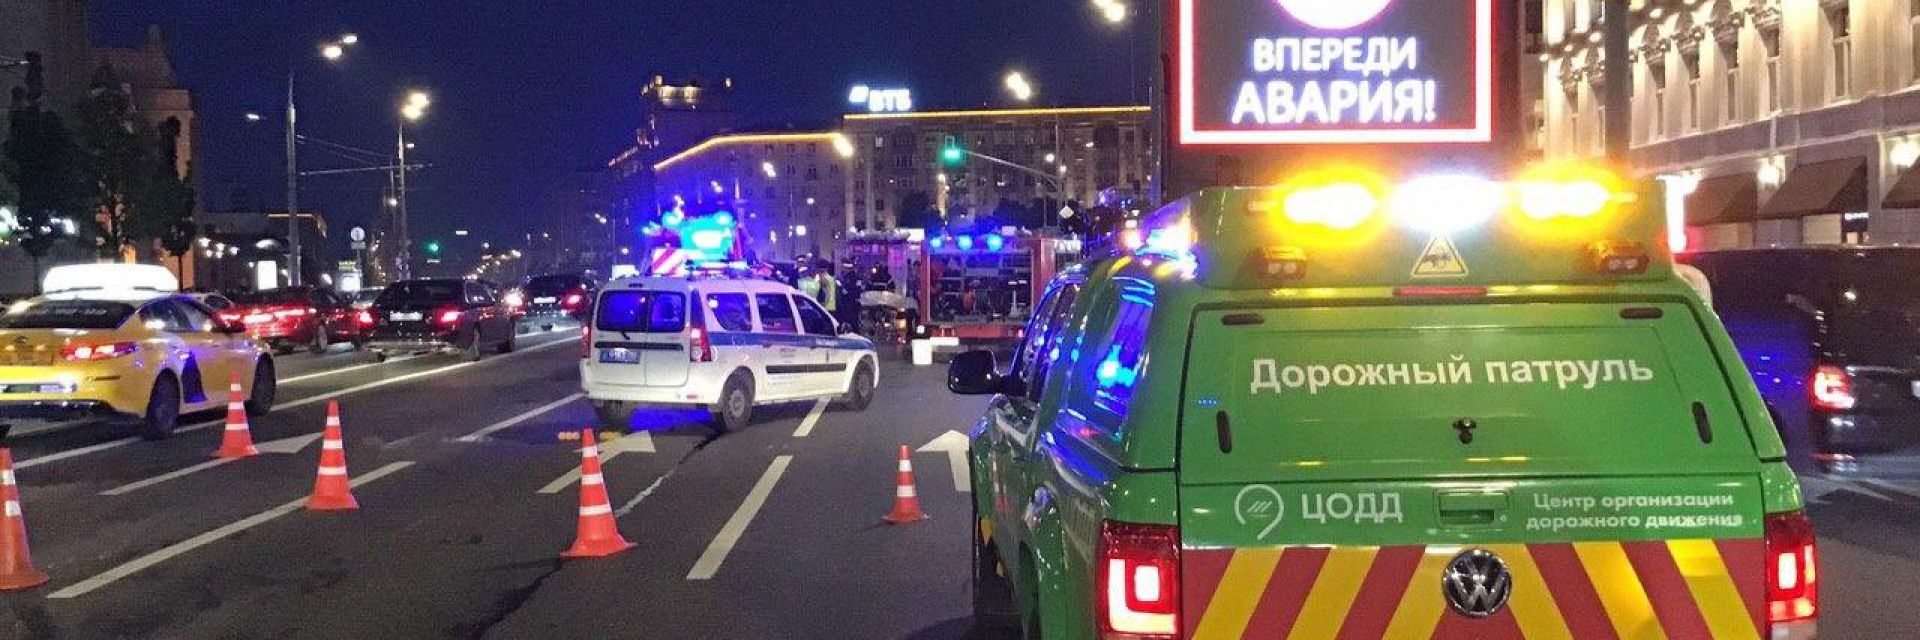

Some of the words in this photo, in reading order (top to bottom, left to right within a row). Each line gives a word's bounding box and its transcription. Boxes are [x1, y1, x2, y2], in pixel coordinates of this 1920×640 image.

[1253, 36, 1417, 77] ВПЕРЕДИ
[1231, 78, 1437, 124] АВАРИЯ!
[1250, 353, 1473, 395] Дорожный
[1484, 358, 1654, 390] патруль
[1301, 492, 1404, 525] ЦОДД
[1533, 493, 1596, 511] Центр
[1601, 493, 1735, 511] организации
[1526, 514, 1640, 532] дорожного
[1645, 513, 1743, 529] движения
